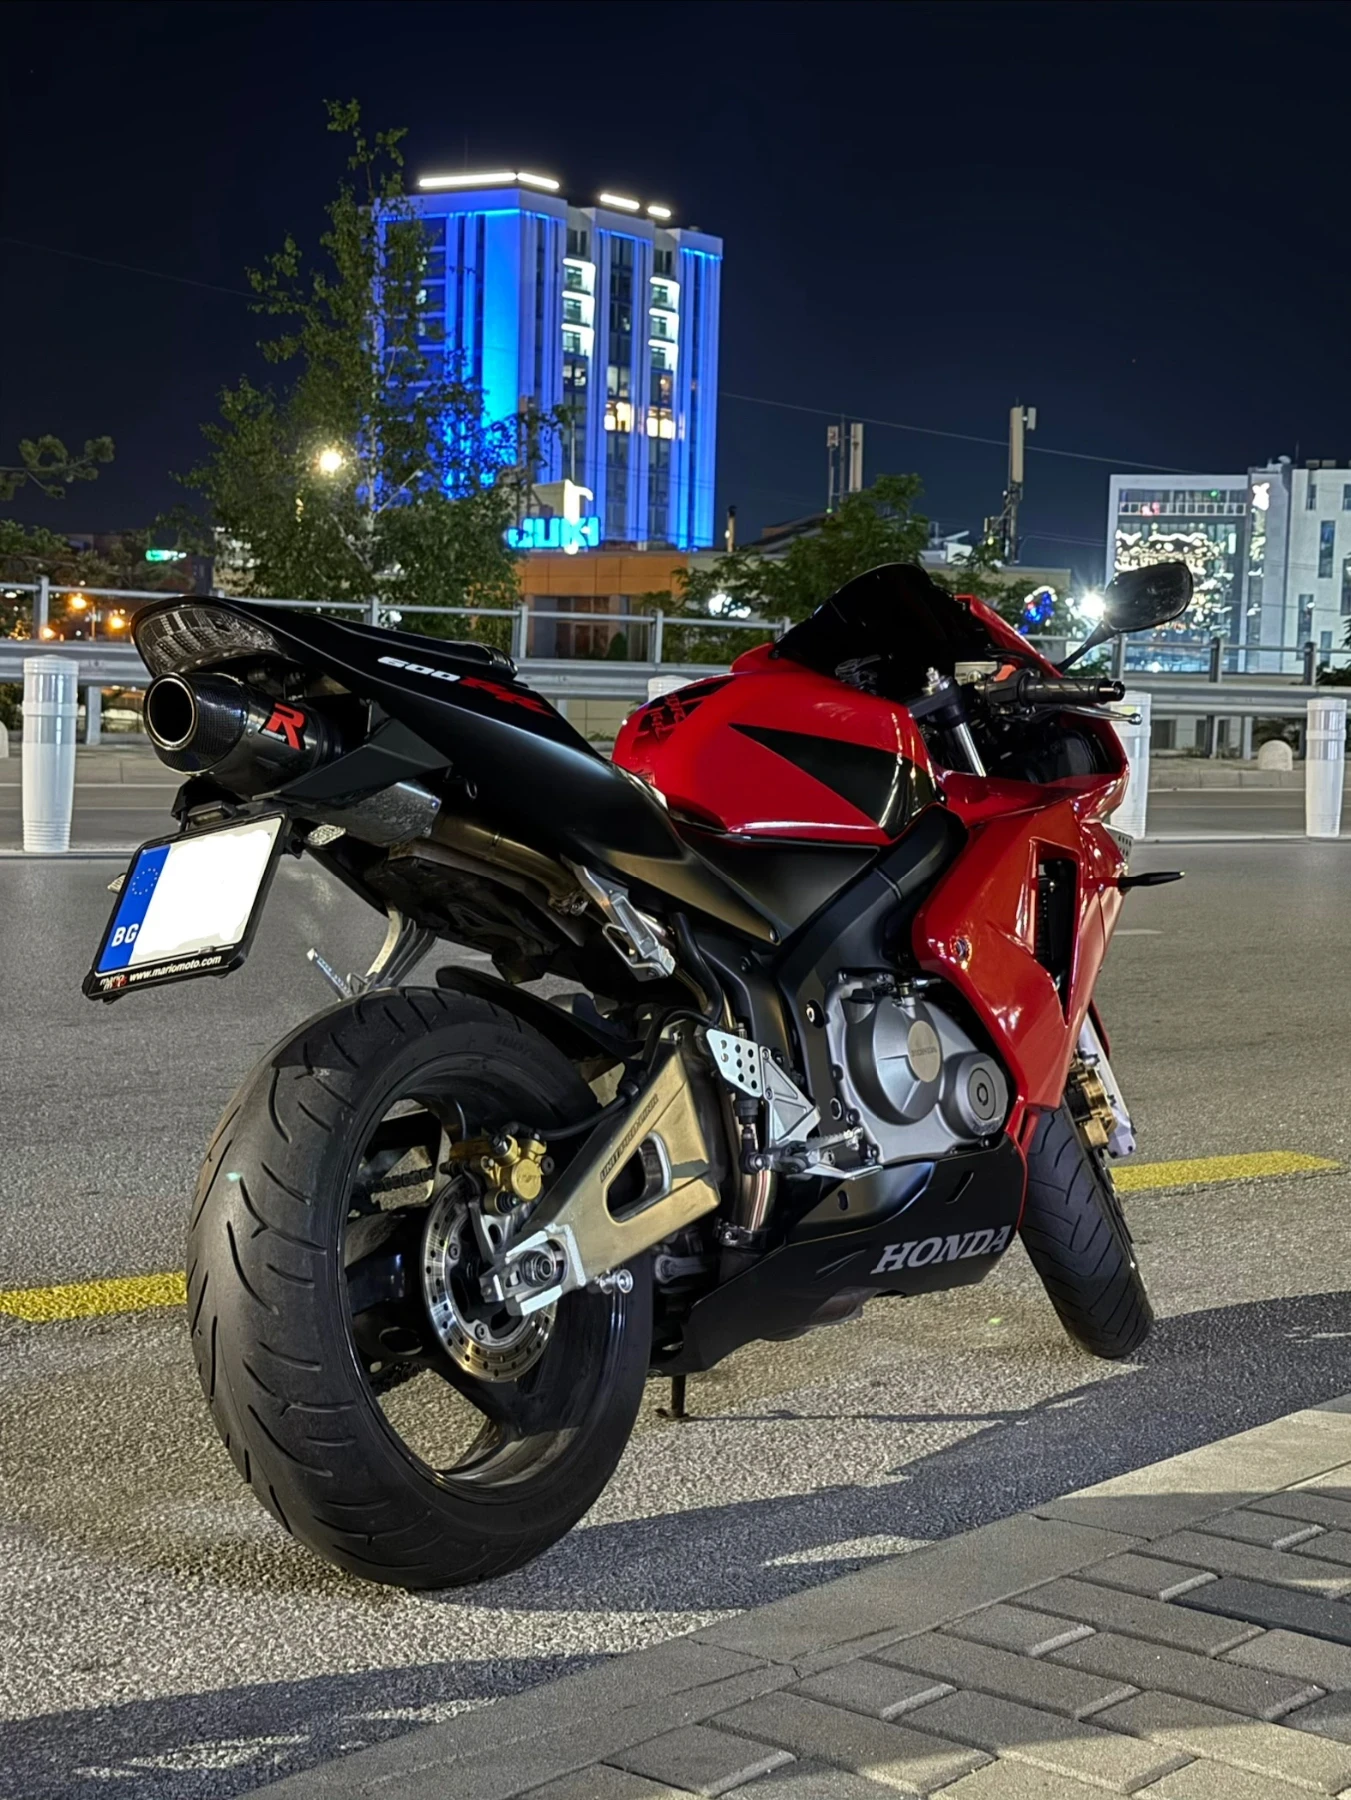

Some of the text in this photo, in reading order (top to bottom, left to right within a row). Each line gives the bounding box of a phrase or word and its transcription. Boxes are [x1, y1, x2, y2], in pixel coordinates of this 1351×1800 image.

[264, 702, 305, 751] R
[111, 923, 140, 947] BG
[129, 955, 222, 982] www.mariomoto.com
[869, 1224, 1012, 1275] HONDA
